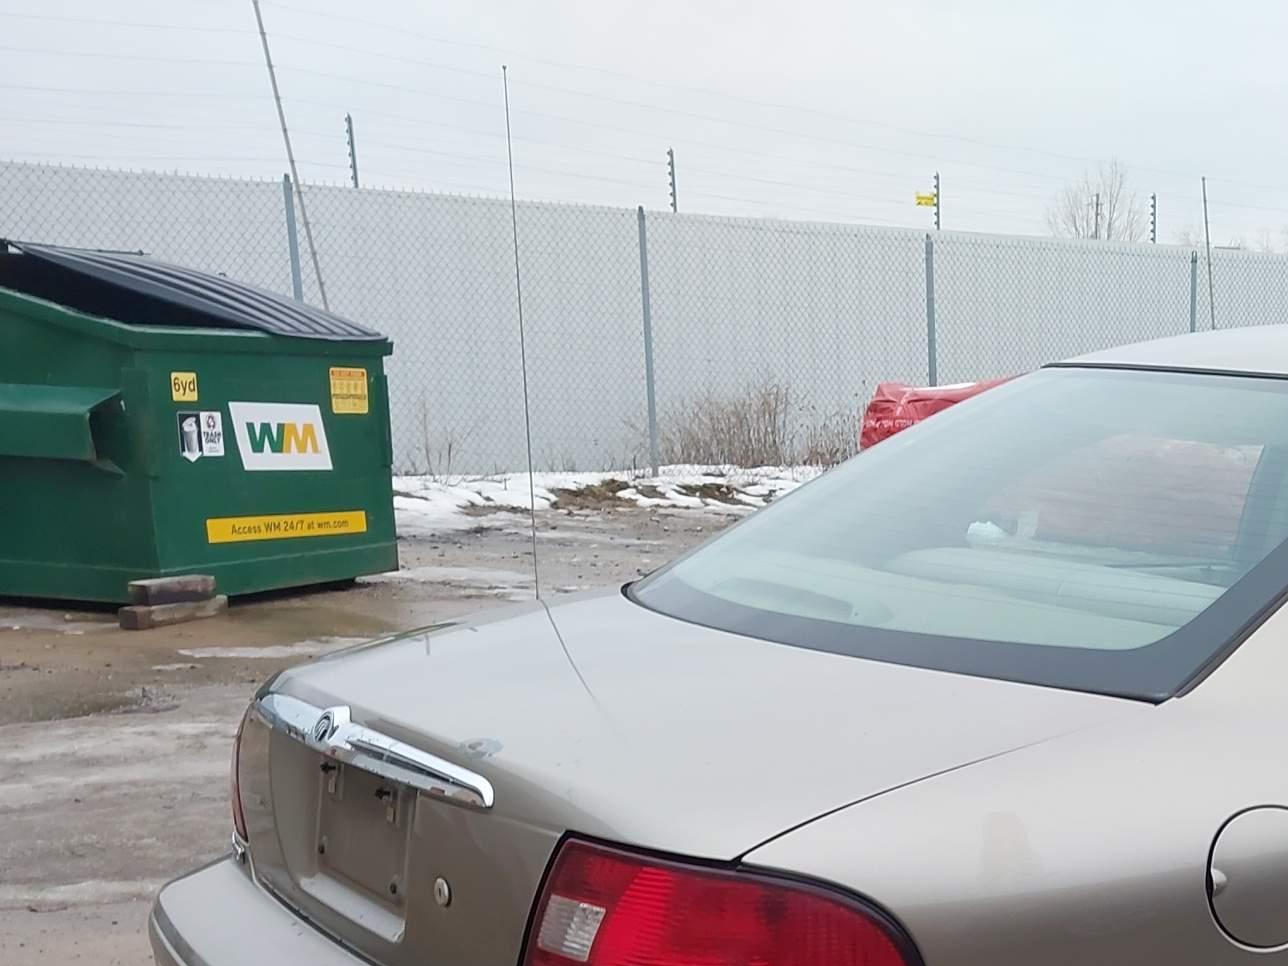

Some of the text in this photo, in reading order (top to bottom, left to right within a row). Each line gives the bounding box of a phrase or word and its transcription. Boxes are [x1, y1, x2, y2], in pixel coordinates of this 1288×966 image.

[173, 376, 196, 396] 6yd
[245, 422, 320, 453] WM
[231, 519, 349, 535] Access WM 24/7 at wm.com
